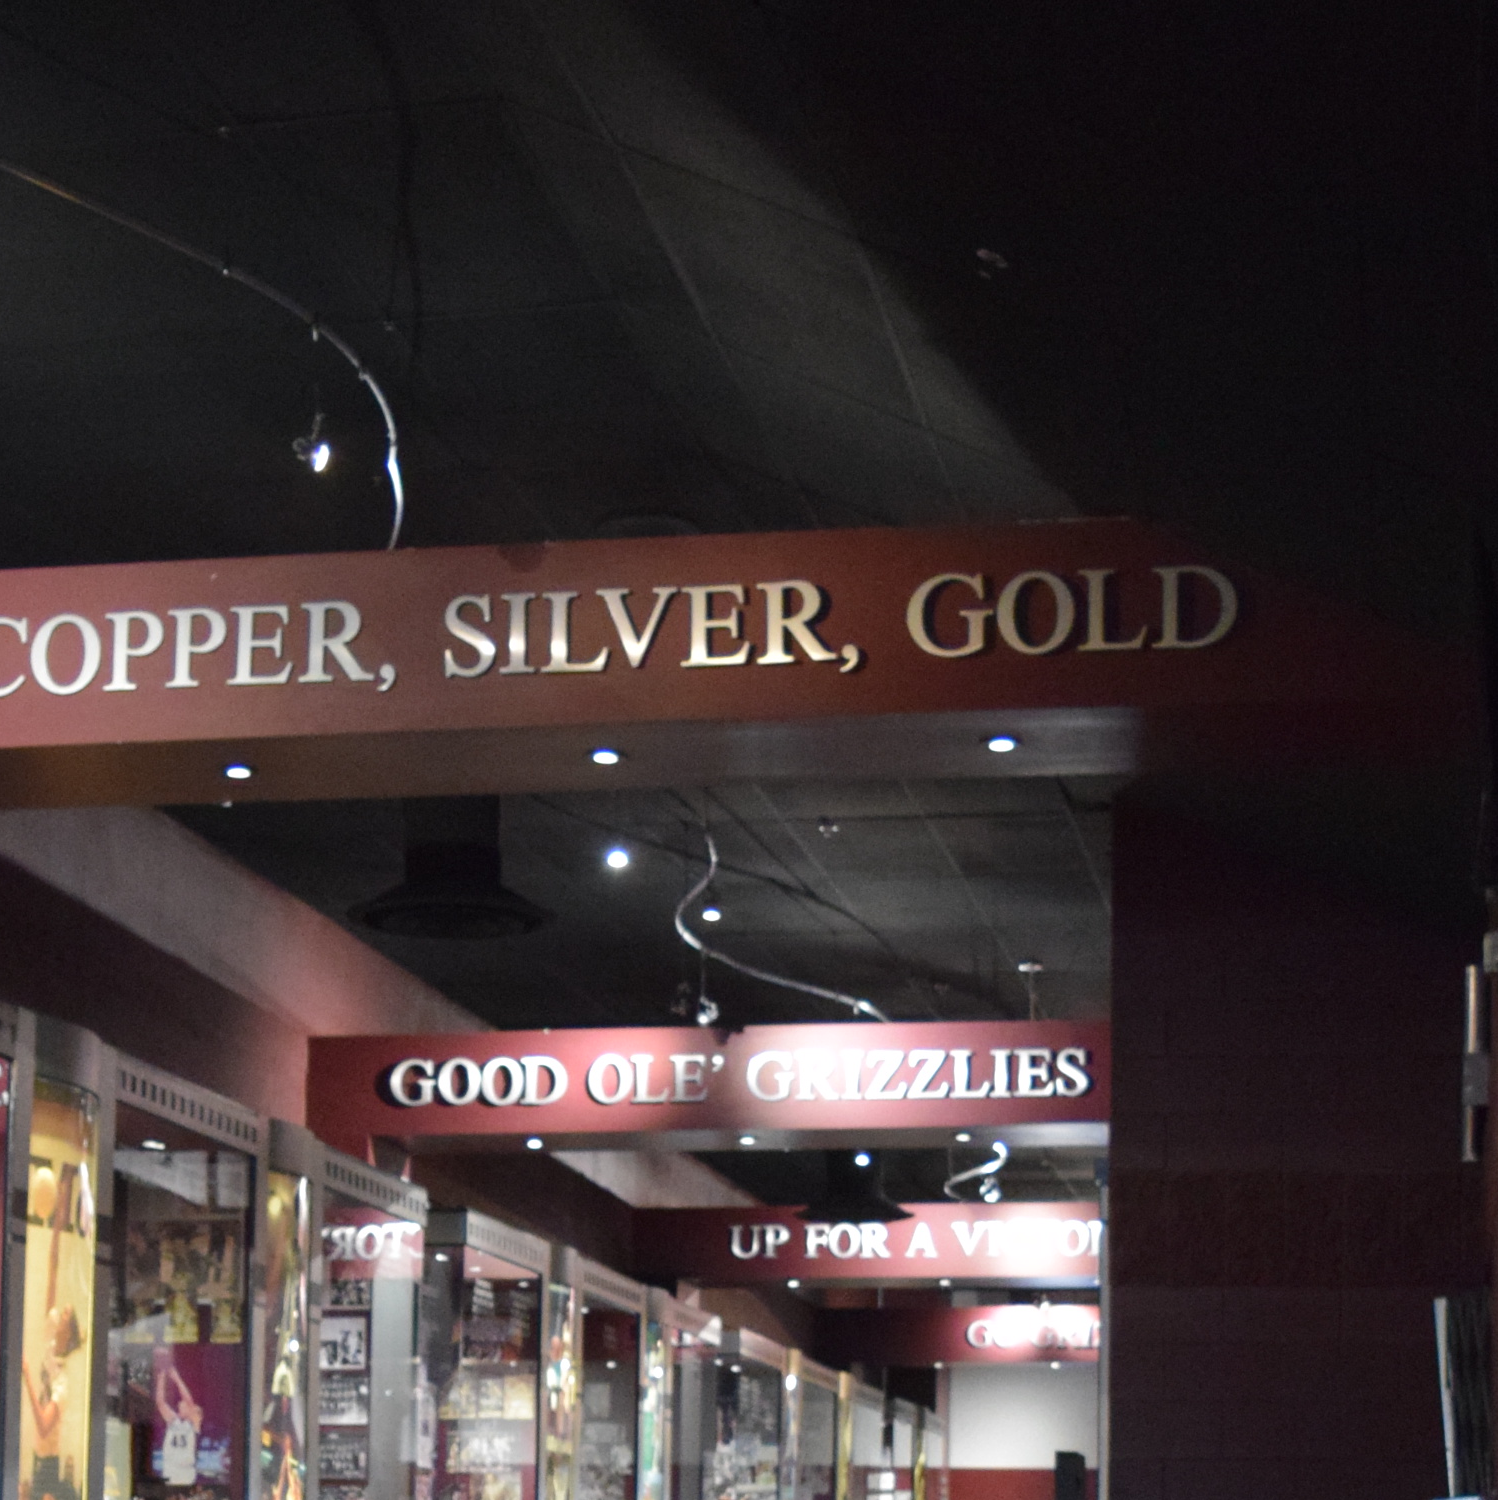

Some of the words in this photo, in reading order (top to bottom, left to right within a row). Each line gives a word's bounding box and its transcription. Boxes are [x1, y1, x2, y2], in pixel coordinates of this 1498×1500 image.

[444, 579, 861, 679] SILVER,
[906, 565, 1239, 658] GOLD
[389, 1054, 568, 1107] GOOD
[586, 1052, 725, 1105] OLE'
[746, 1048, 1091, 1102] GRIZZLIES
[730, 1223, 791, 1259] UP
[804, 1221, 890, 1260] FOR
[904, 1221, 938, 1259] A
